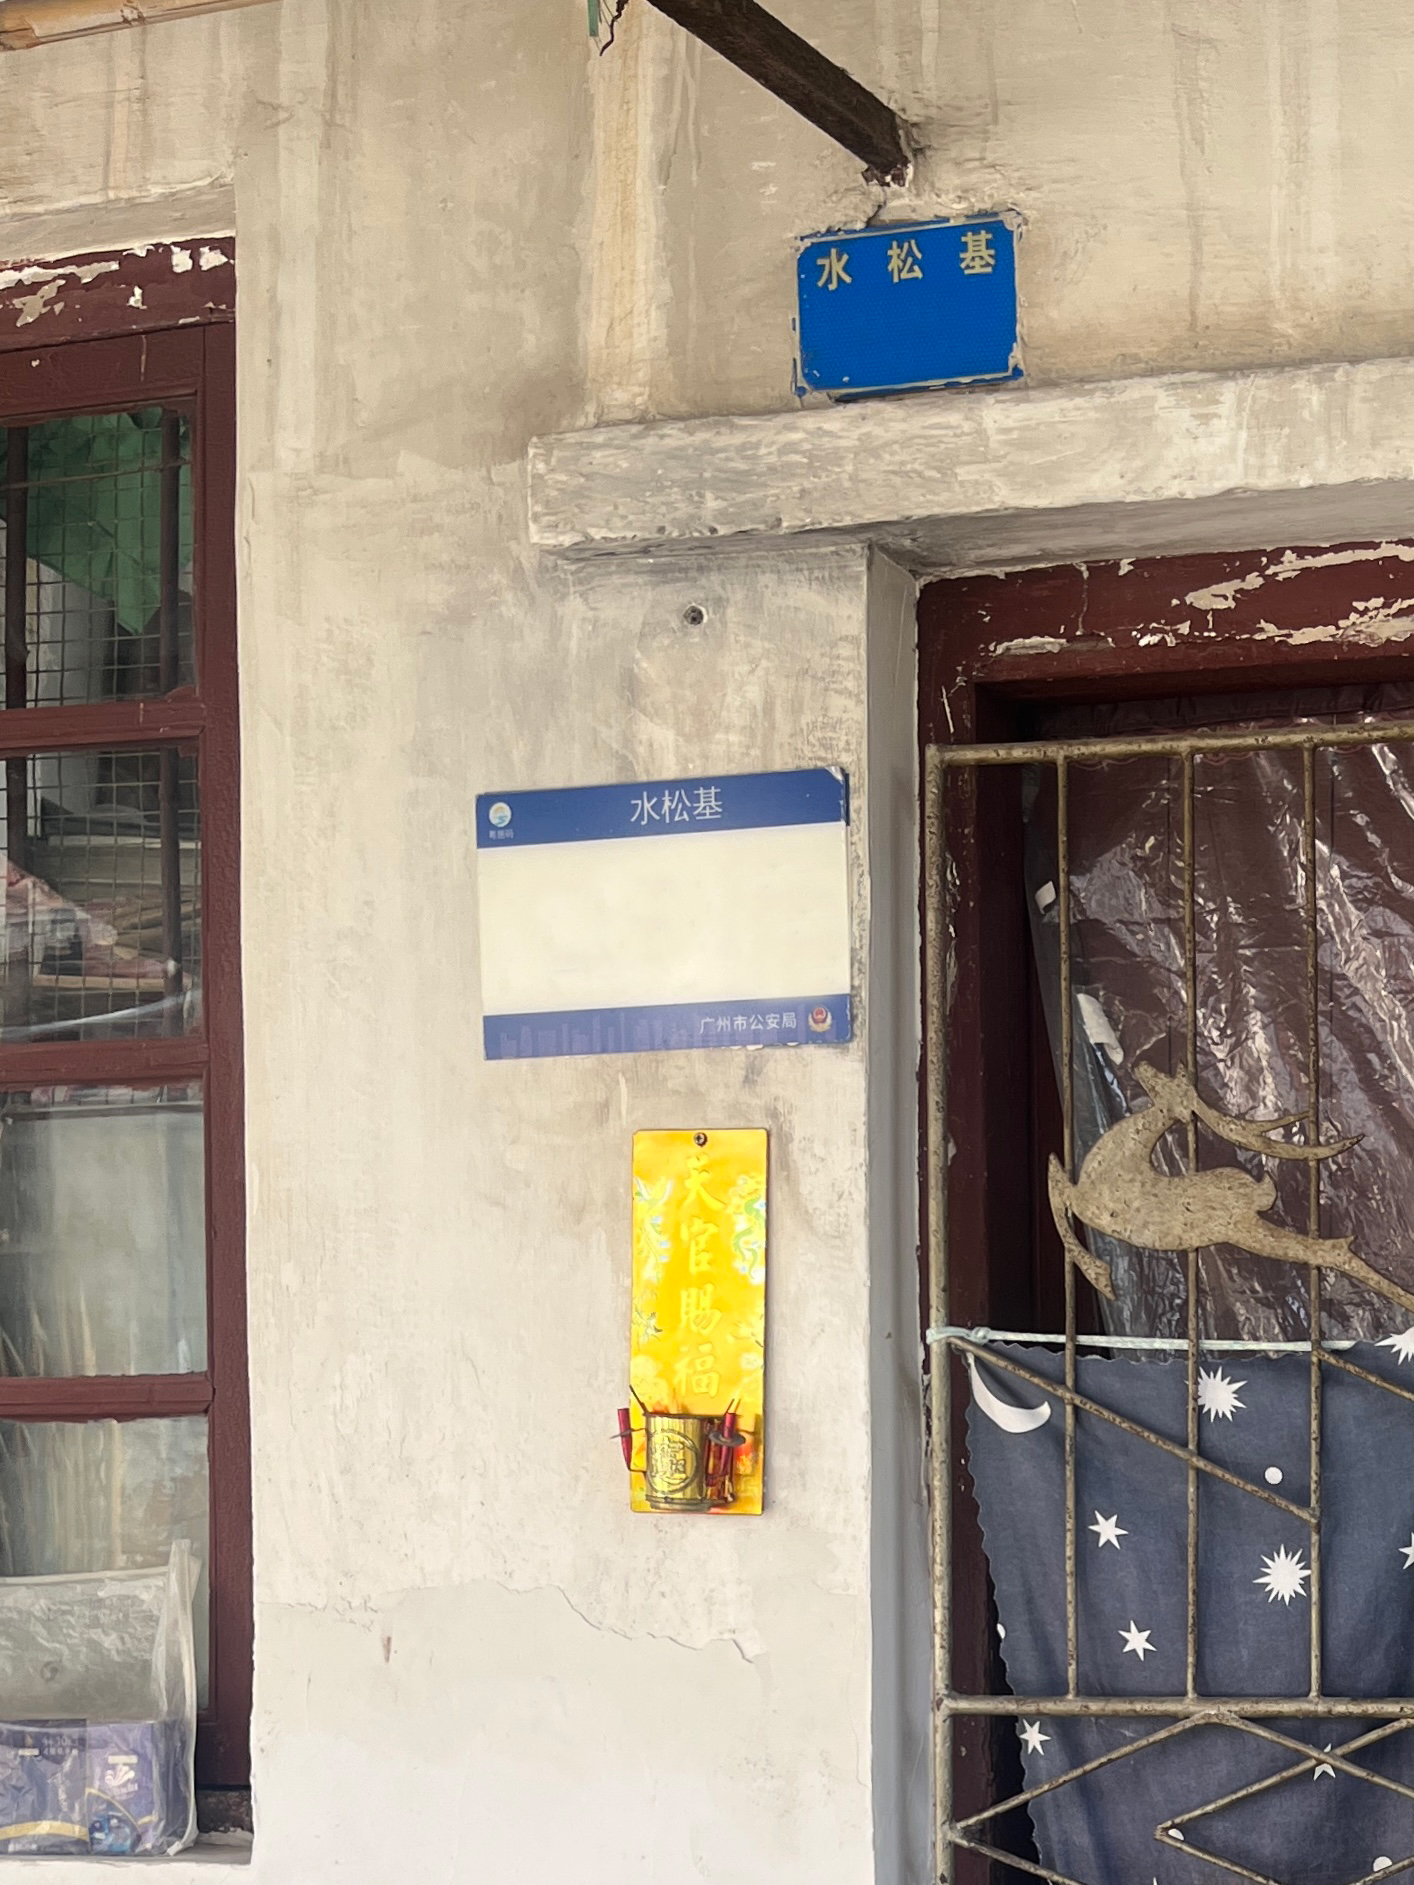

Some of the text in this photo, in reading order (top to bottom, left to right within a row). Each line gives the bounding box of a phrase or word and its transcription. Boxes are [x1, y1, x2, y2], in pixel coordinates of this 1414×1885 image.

[816, 230, 996, 291] 水松基
[629, 786, 723, 826] 水松基
[699, 1012, 797, 1034] 广州市公安局
